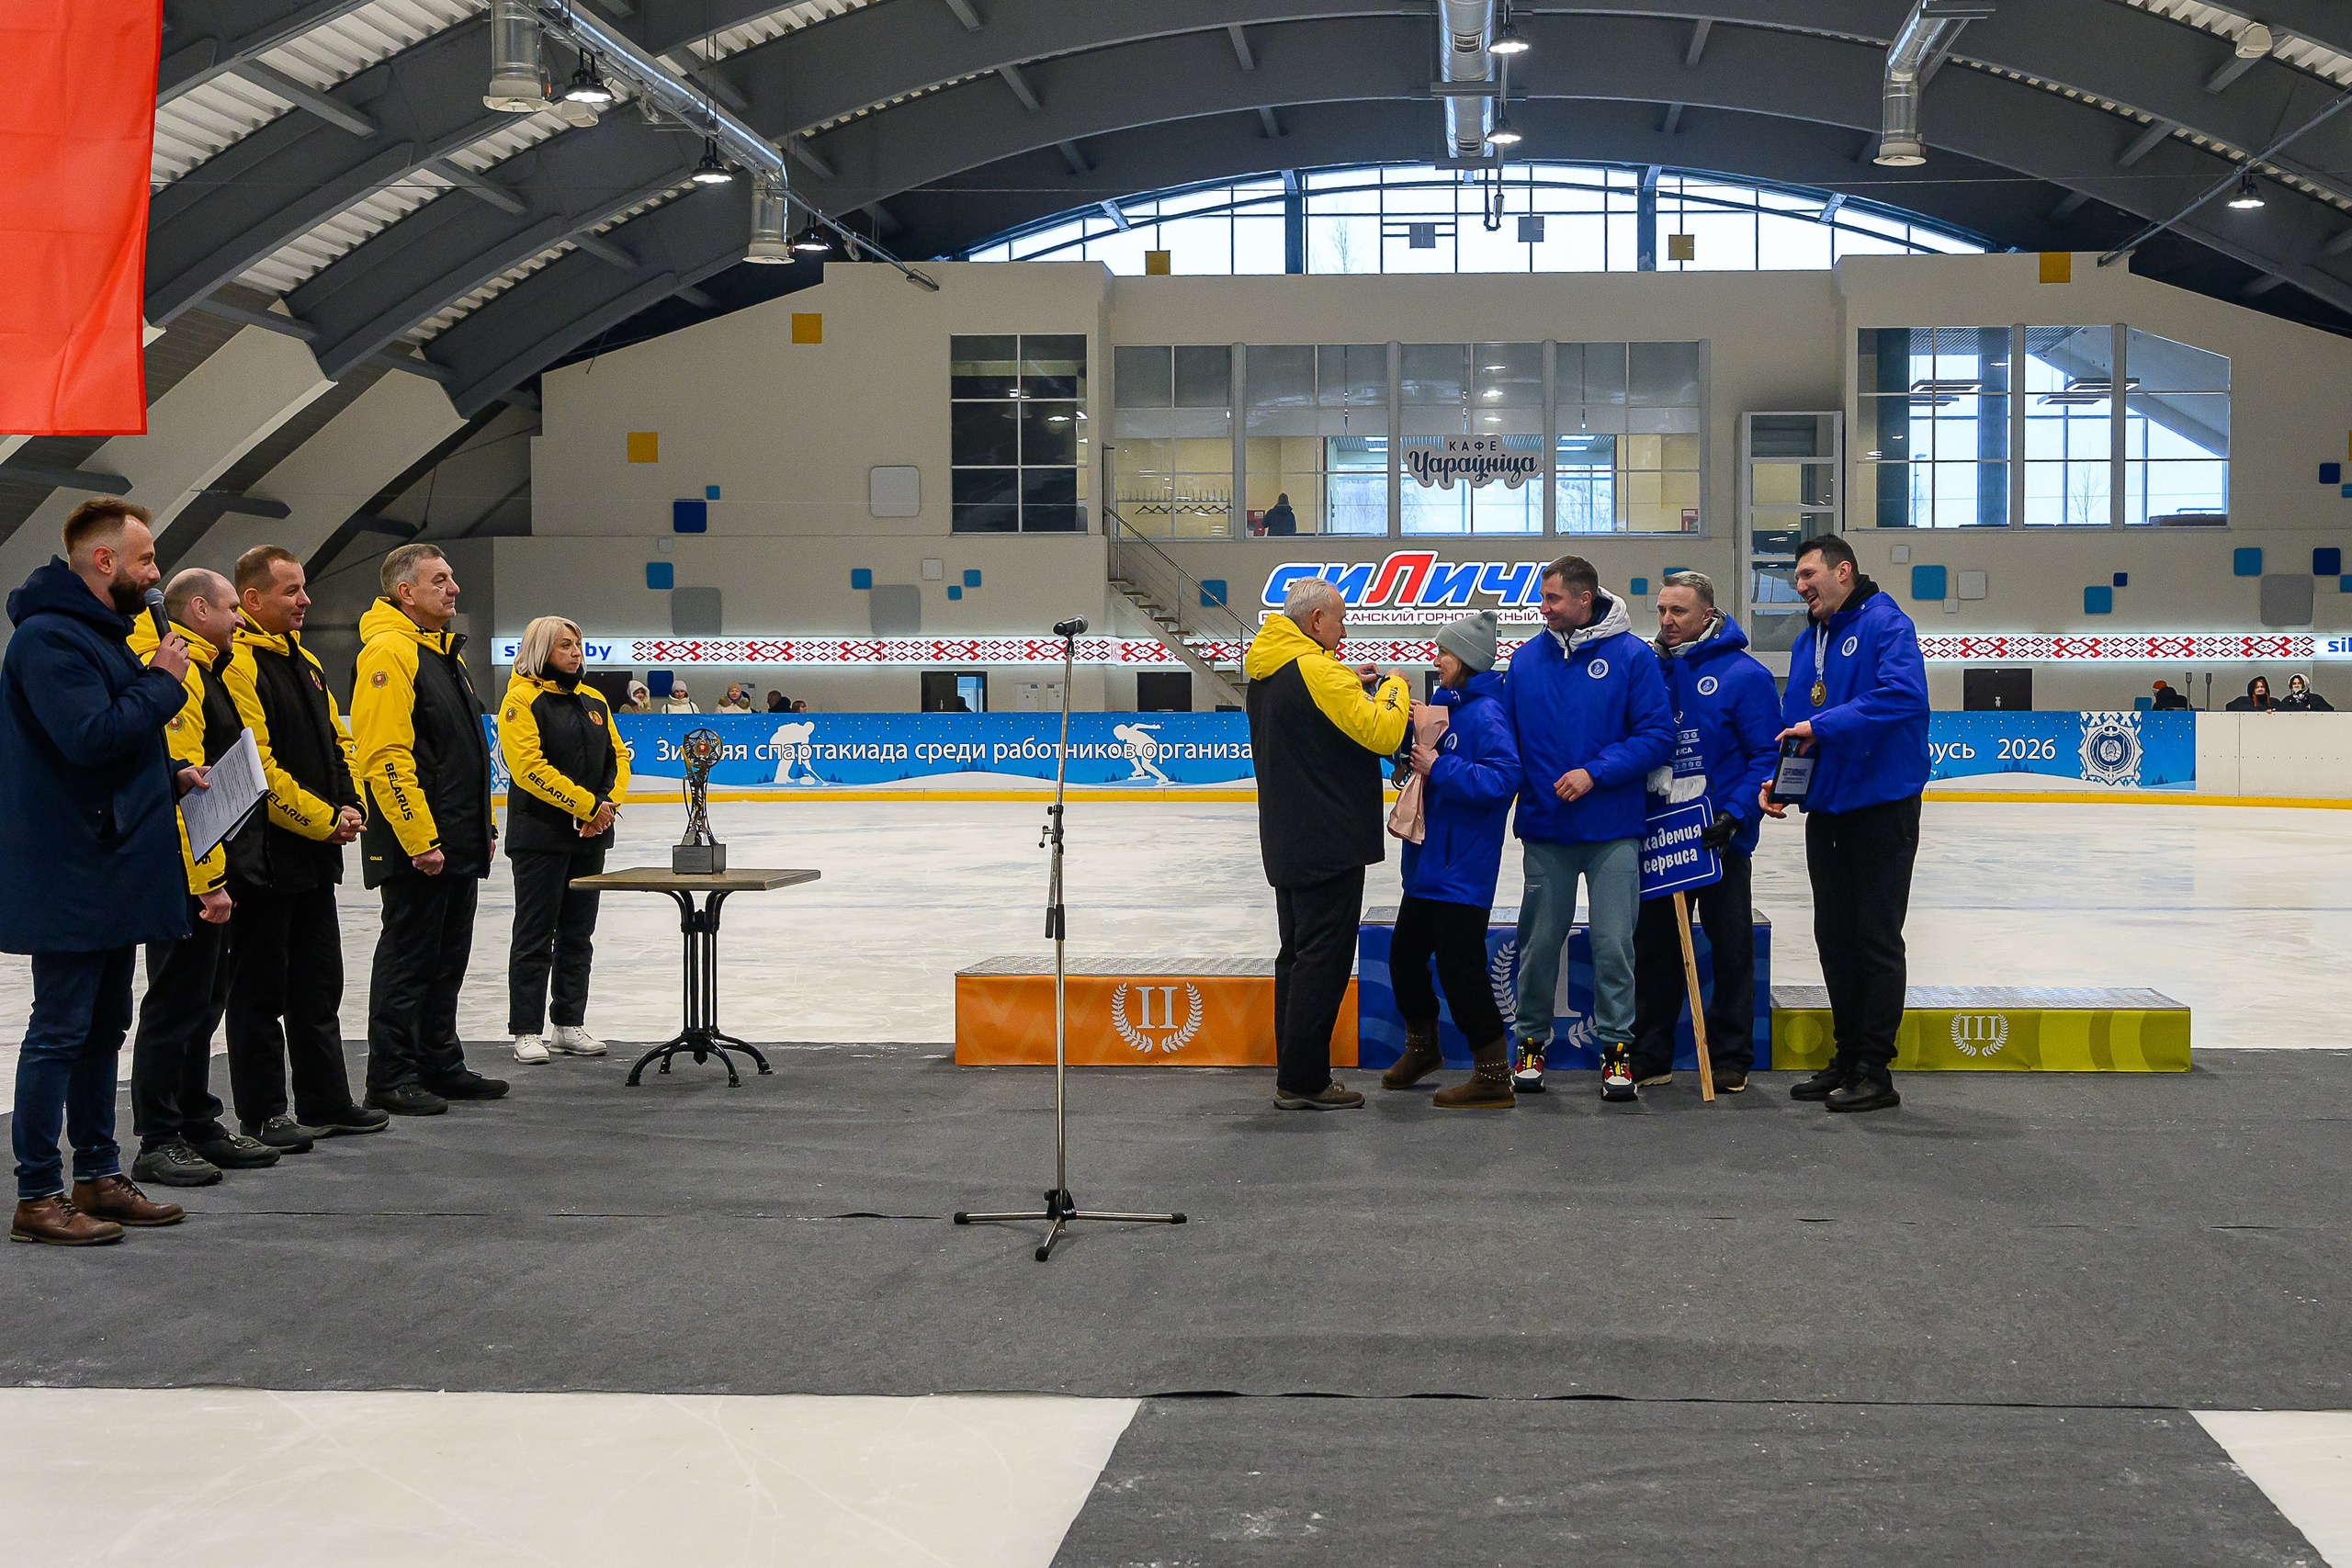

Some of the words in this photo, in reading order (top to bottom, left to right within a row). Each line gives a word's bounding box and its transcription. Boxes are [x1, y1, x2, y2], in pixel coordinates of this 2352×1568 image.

[1449, 441, 1497, 451] КАФЕ
[1408, 450, 1537, 483] Чараўніца
[656, 739, 747, 761] Зияя
[754, 743, 907, 765] спартакиада
[915, 742, 986, 764] среди
[994, 738, 1137, 764] работников
[1141, 742, 1253, 764] организа
[1996, 739, 2056, 760] 2026
[385, 762, 413, 821] BELARUS
[528, 773, 577, 807] BELARUS
[266, 792, 311, 827] ELARUS
[1644, 848, 1698, 875] сервиса
[1136, 986, 1179, 1029] II
[1962, 1015, 1998, 1040] III
